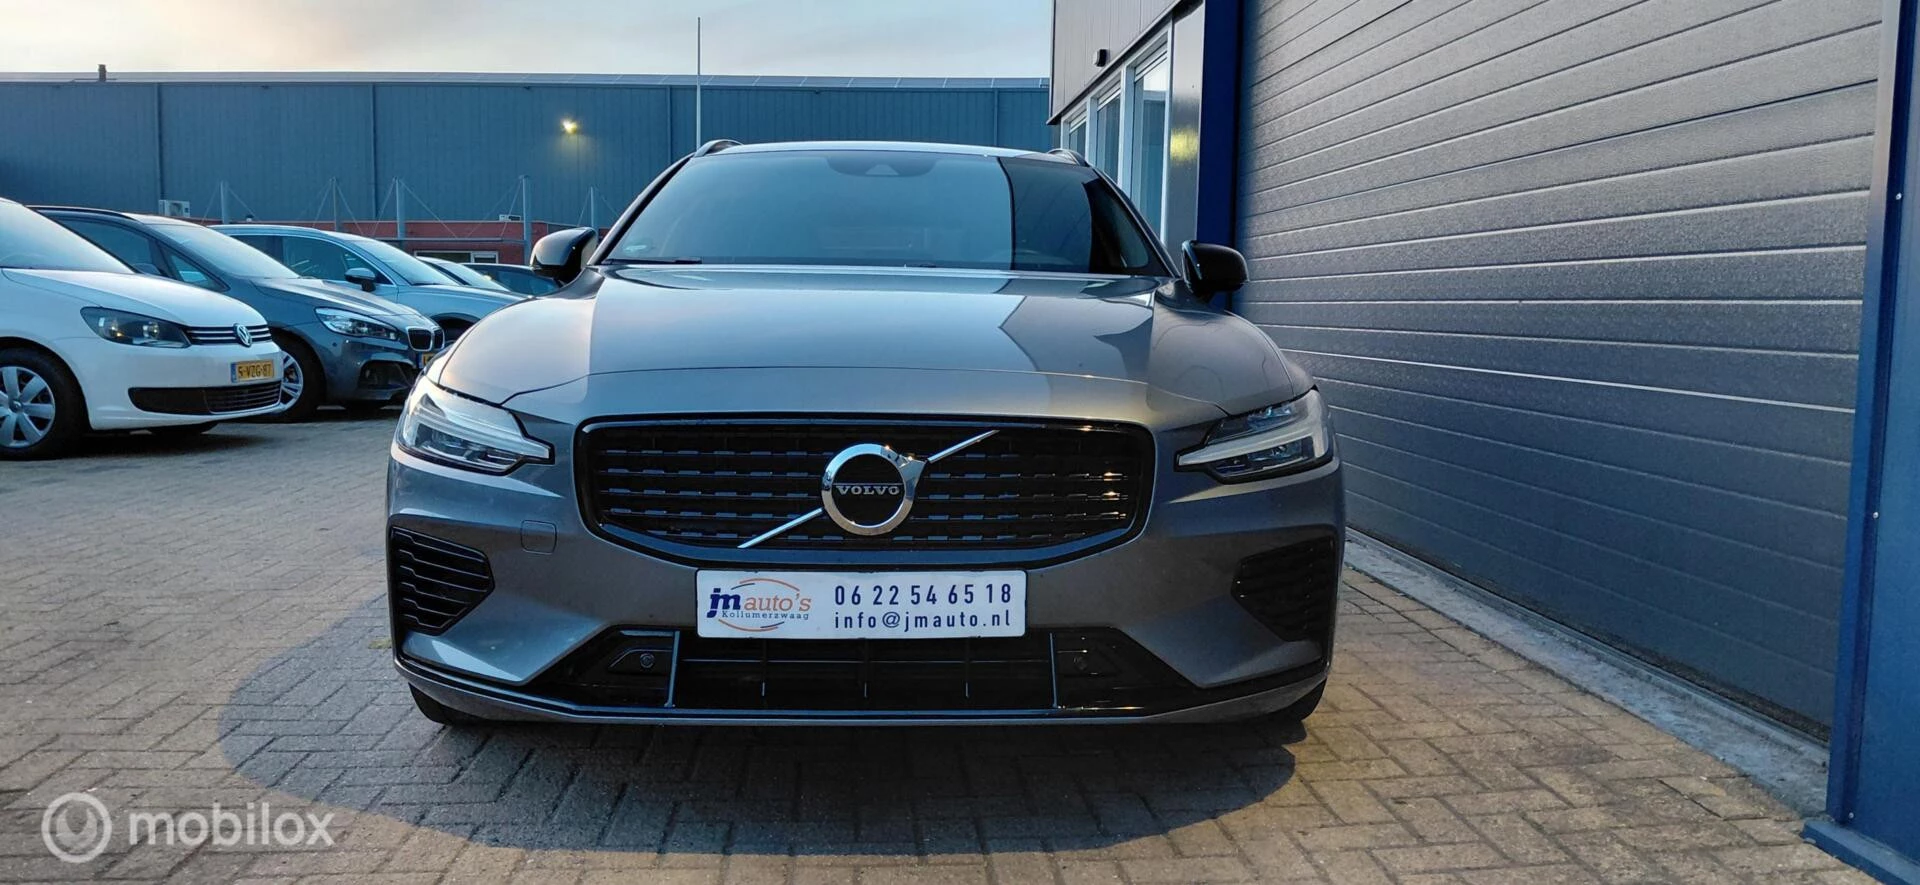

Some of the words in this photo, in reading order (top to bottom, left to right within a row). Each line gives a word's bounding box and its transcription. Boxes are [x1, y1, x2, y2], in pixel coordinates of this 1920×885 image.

[836, 485, 900, 495] VOLVO
[835, 585, 861, 605] 06
[873, 585, 899, 605] 22
[910, 584, 937, 605] 54
[948, 584, 974, 604] 65
[986, 583, 1011, 604] 18
[721, 609, 809, 620] Kollumerzwaag
[835, 609, 1010, 632] info@jmauto.nl
